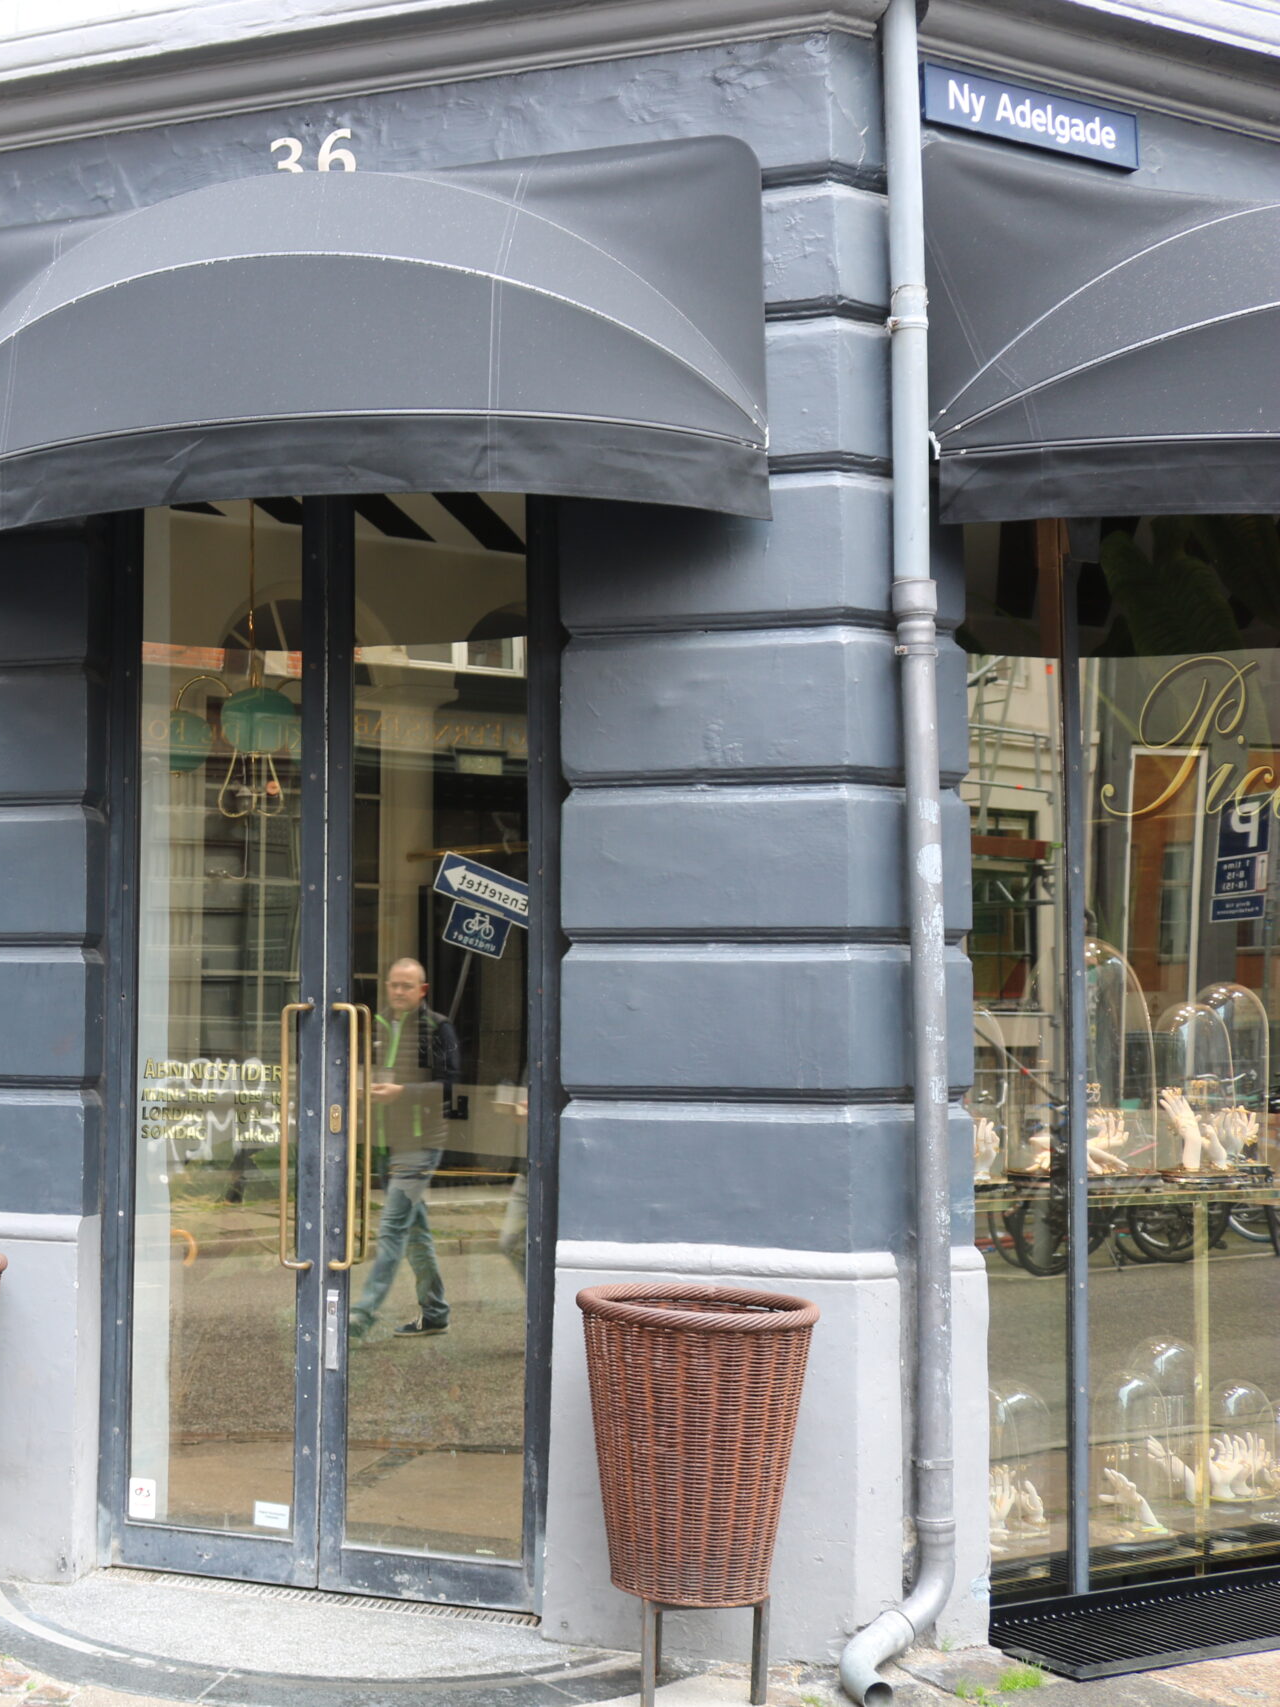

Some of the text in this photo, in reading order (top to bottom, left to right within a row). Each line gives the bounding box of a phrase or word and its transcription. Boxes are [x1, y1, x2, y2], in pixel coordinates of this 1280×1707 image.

[948, 79, 1117, 149] Ny Adelgade
[270, 128, 357, 173] 36
[1100, 655, 1280, 820] Pic
[141, 1124, 208, 1141] SØNDAG
